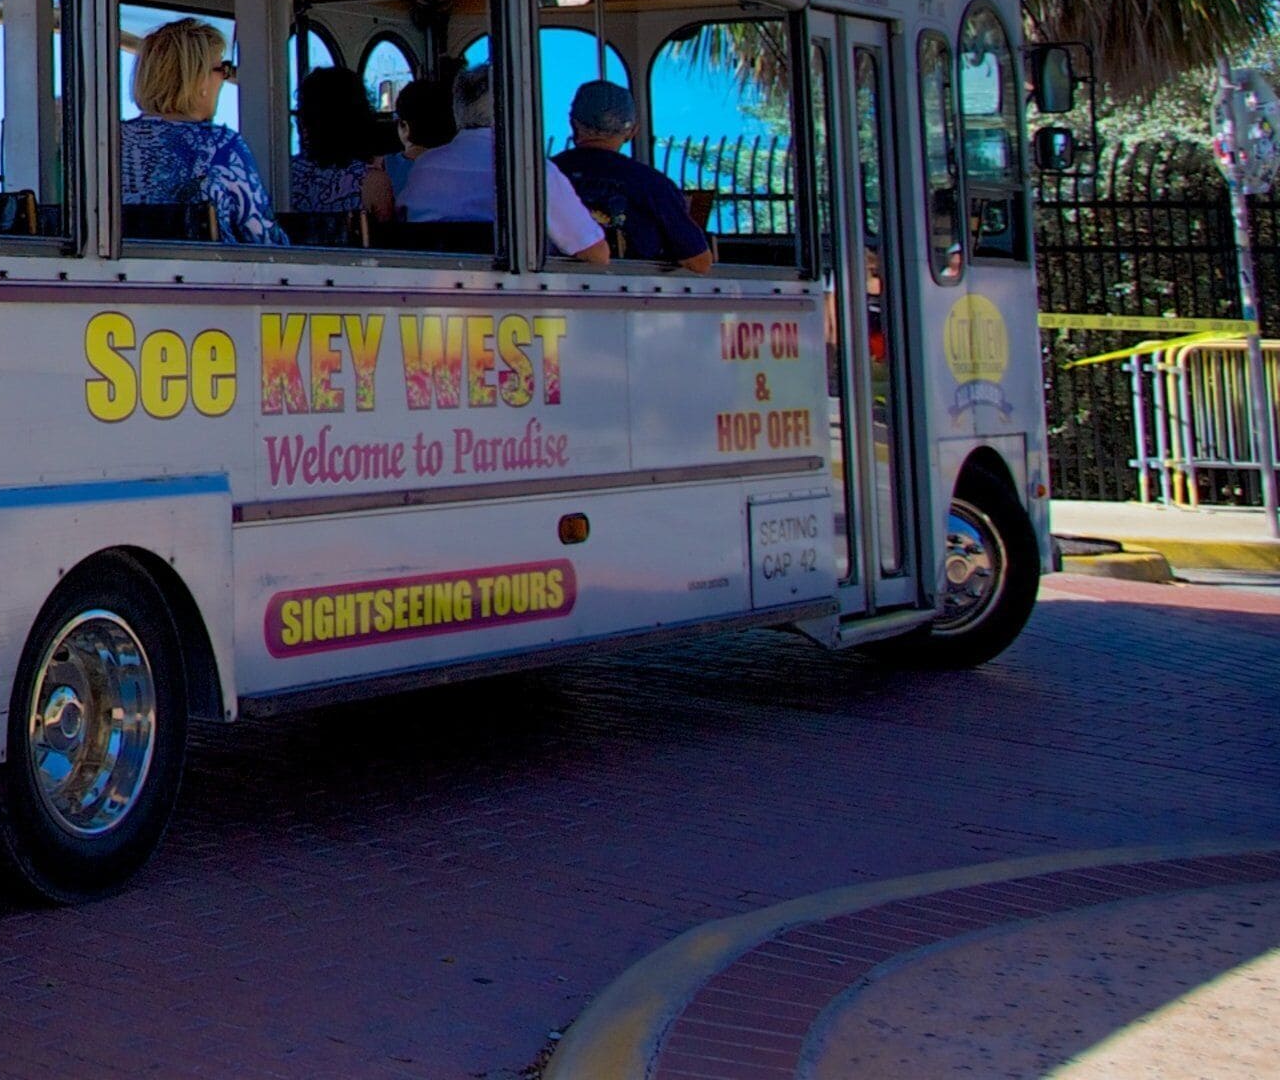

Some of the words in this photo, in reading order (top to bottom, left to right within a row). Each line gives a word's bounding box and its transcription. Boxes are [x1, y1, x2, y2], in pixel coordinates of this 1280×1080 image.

[721, 322, 764, 360] HOP
[771, 322, 799, 359] ON
[84, 310, 237, 423] See
[260, 312, 386, 415] KEY
[399, 313, 568, 411] WEST
[755, 373, 772, 402] &
[716, 411, 760, 452] HOP
[766, 410, 811, 449] OFF!
[263, 425, 407, 487] Welcome
[413, 431, 443, 477] to
[452, 417, 570, 475] Paradise
[759, 514, 817, 546] SEATING
[762, 552, 792, 580] CAP
[799, 548, 817, 572] 42
[280, 576, 472, 647] SIGHTSEEING
[477, 567, 564, 618] TOURS
